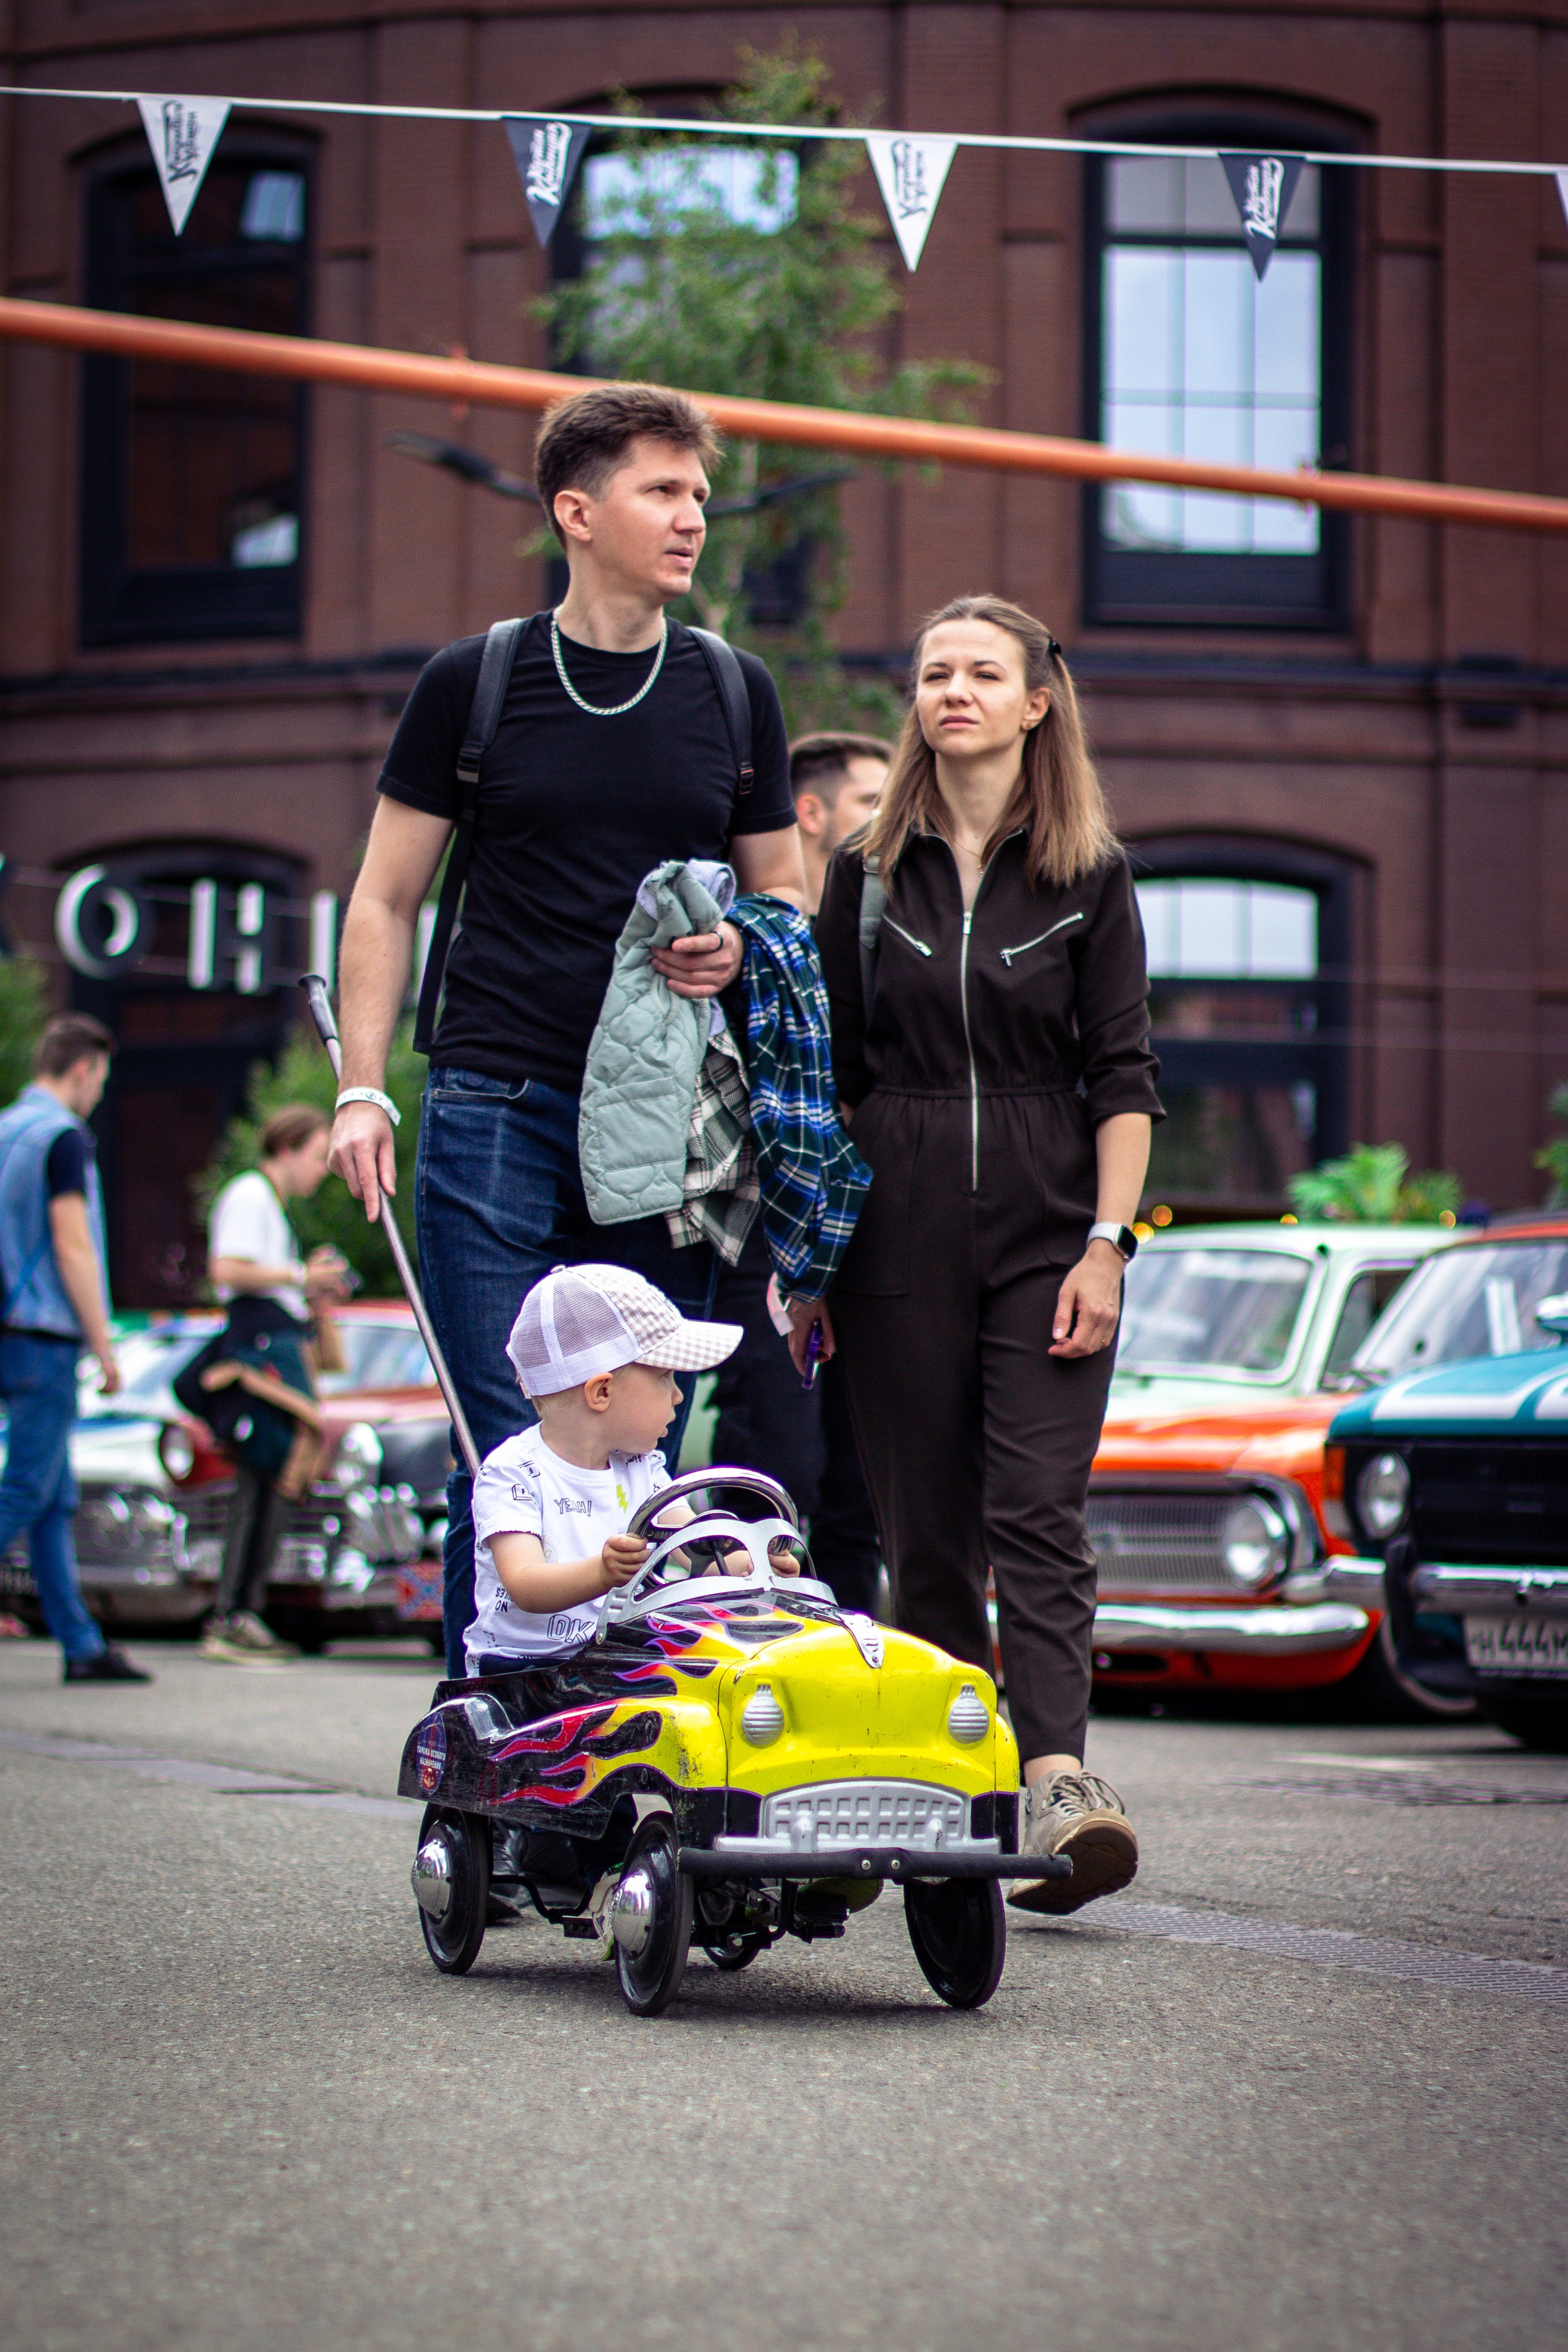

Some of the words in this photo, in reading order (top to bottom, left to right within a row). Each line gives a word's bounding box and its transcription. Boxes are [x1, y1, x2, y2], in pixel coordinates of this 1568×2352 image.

[554, 1498, 592, 1517] YEAH!
[495, 1600, 508, 1613] NO
[547, 1614, 595, 1644] OK
